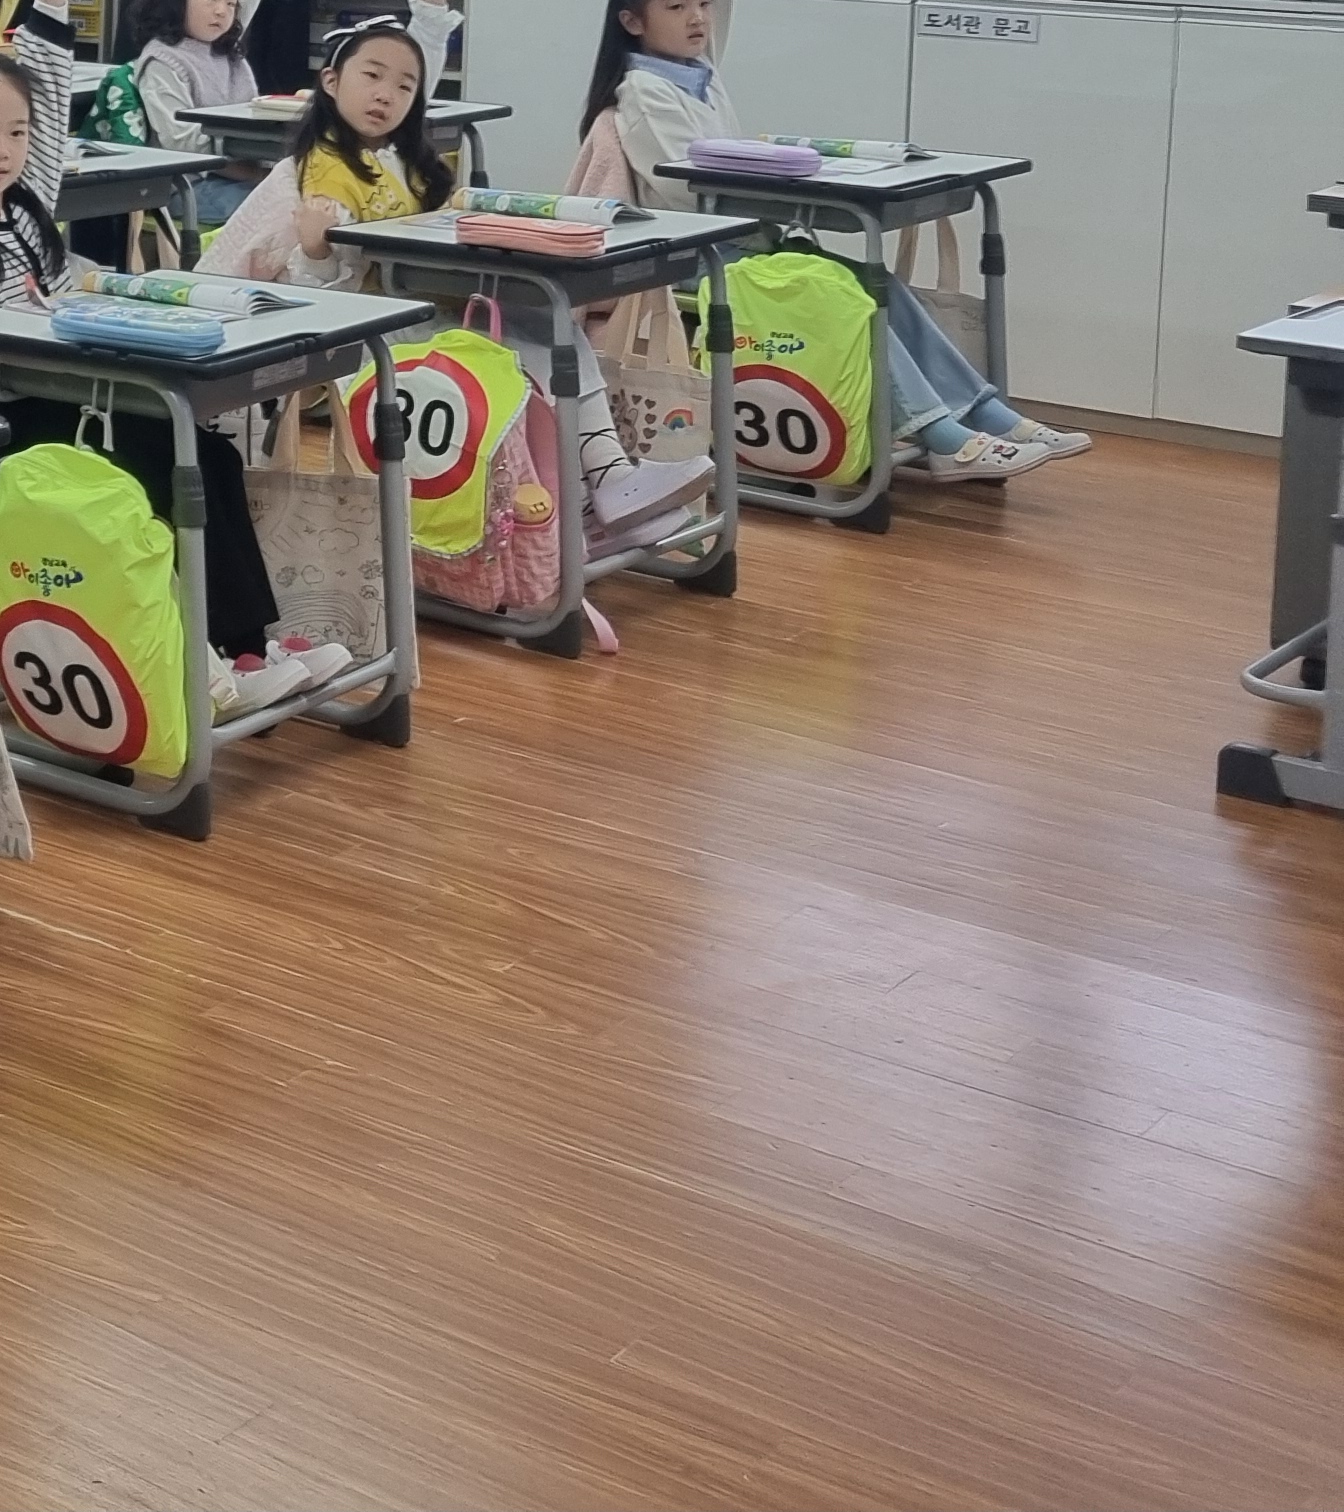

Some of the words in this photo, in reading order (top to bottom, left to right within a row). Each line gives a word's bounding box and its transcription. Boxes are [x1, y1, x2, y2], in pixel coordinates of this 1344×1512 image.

[923, 13, 982, 35] 도서관
[992, 17, 1032, 37] 문고
[733, 400, 819, 456] 30
[13, 650, 113, 730] 30
